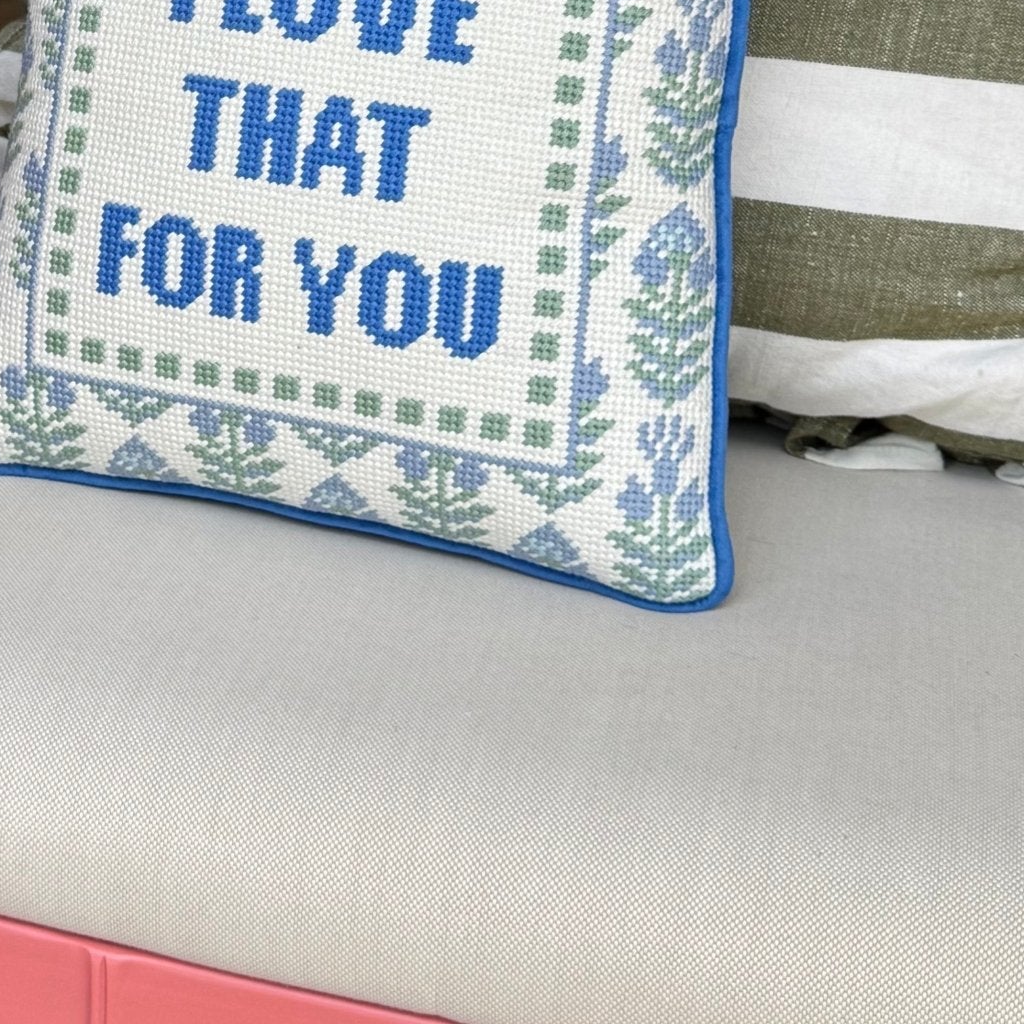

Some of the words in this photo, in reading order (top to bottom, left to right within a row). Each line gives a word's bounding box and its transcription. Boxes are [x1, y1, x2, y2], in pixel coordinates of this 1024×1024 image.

[183, 73, 432, 203] THAT
[96, 202, 264, 324] FOR
[294, 237, 504, 360] YOU
